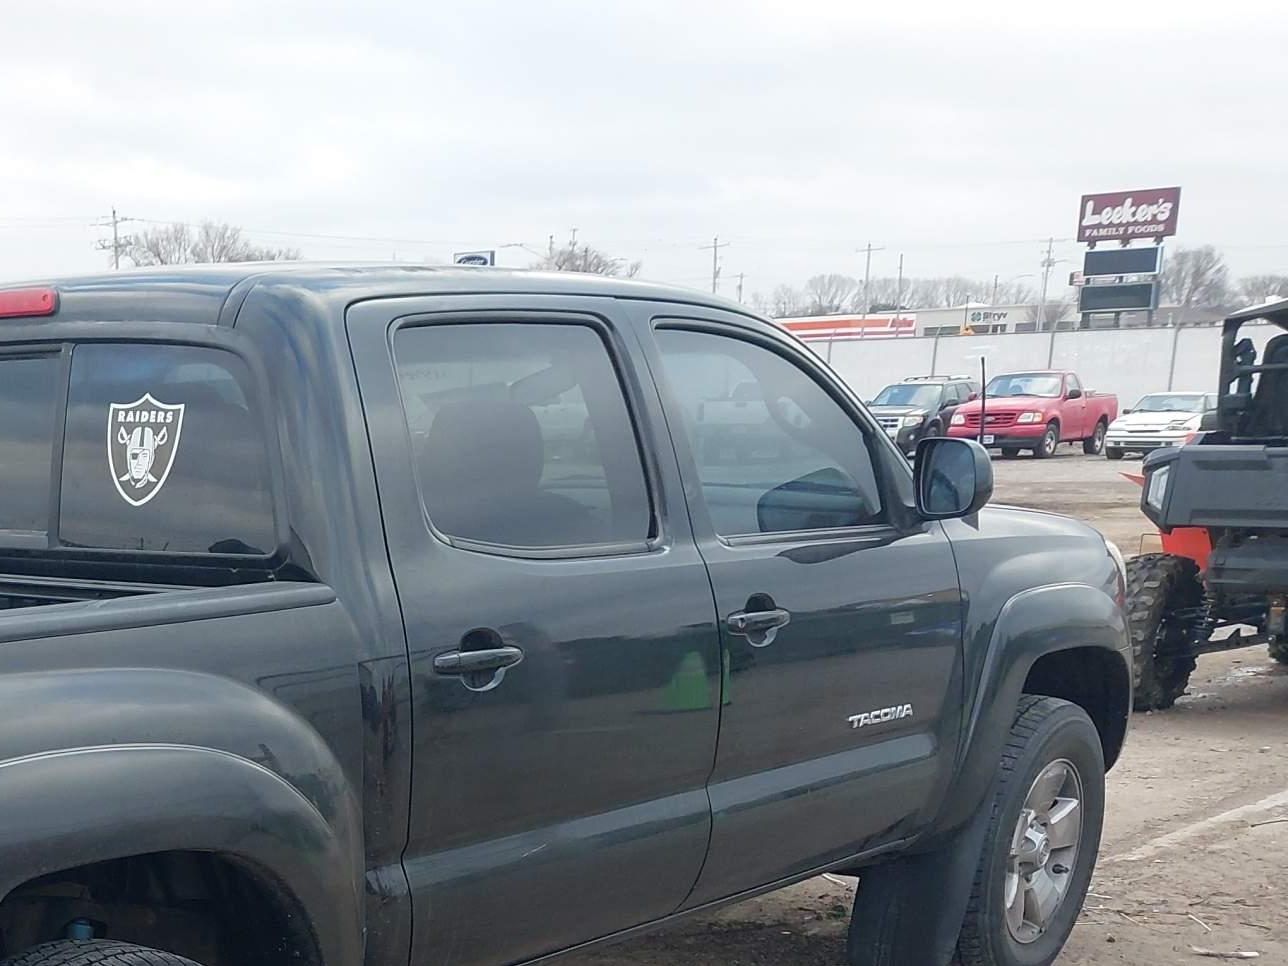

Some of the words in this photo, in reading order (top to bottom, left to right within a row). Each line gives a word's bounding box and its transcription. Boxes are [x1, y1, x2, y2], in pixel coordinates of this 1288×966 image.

[1082, 197, 1174, 227] Leeker's
[1085, 226, 1126, 238] FAMILY
[1127, 223, 1166, 234] FOODS
[117, 410, 174, 424] RAIDERS
[848, 703, 914, 729] TACOMA
